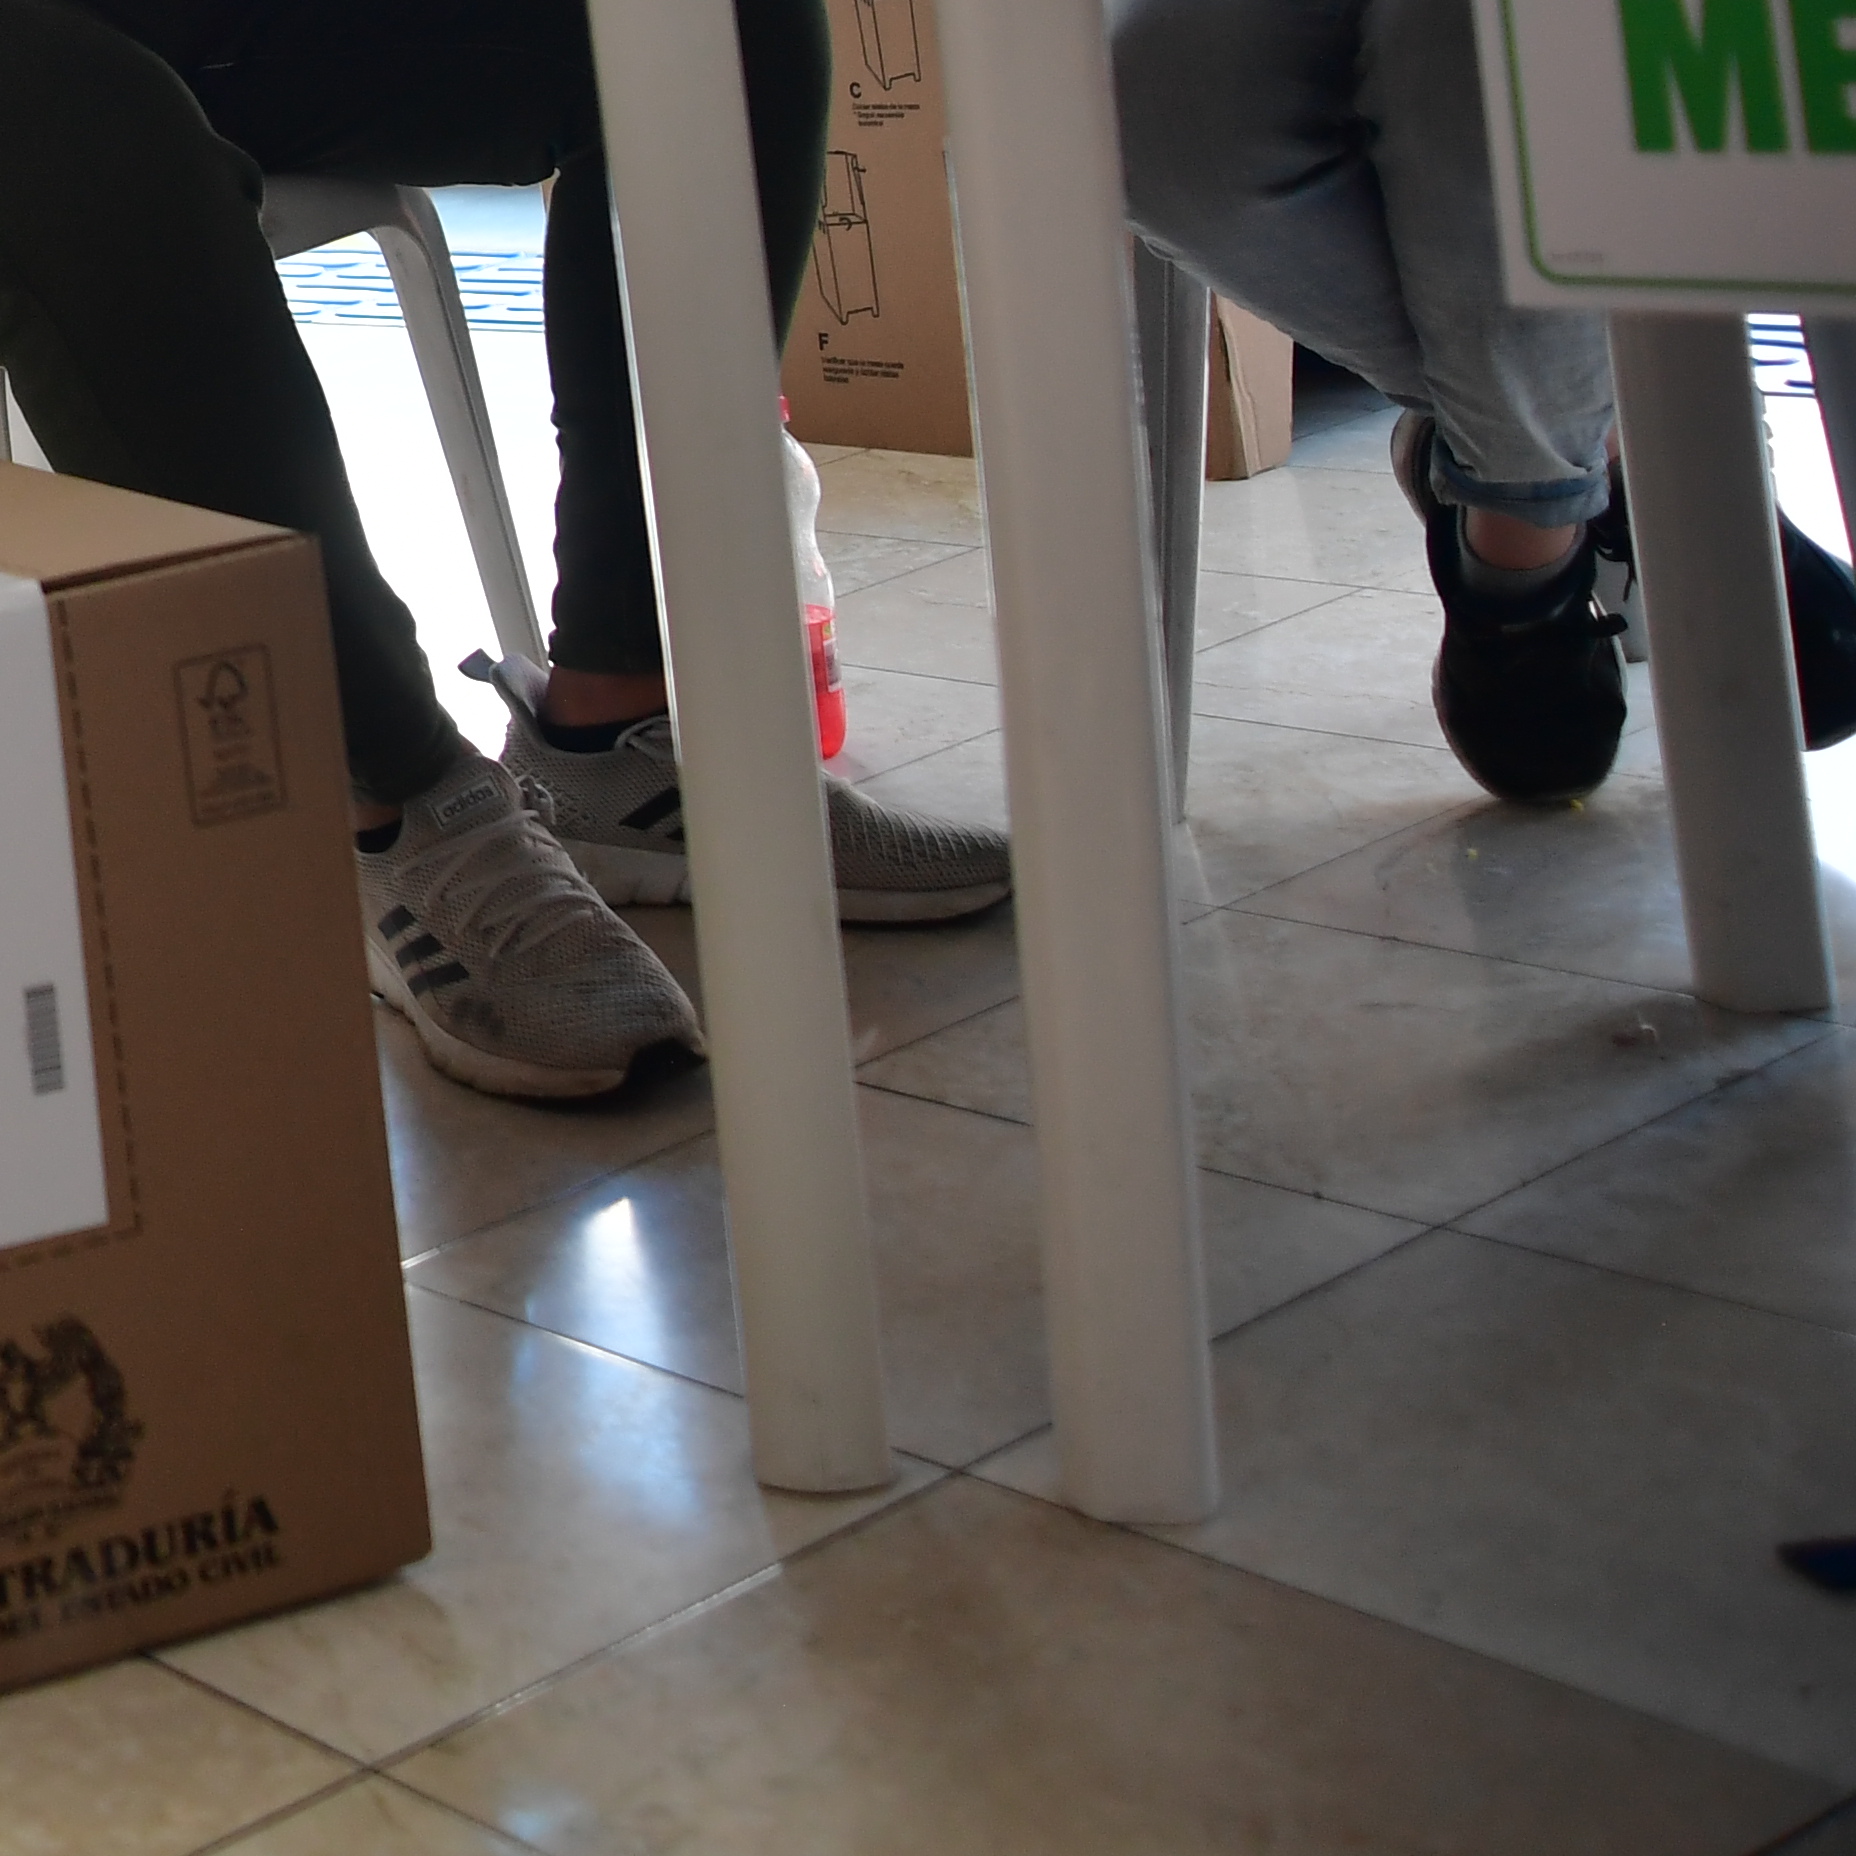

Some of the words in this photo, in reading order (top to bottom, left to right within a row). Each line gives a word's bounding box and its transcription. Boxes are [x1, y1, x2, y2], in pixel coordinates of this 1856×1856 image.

[849, 81, 862, 99] C
[818, 332, 829, 351] F
[442, 784, 494, 818] adidas
[198, 1542, 281, 1585] CIVIL
